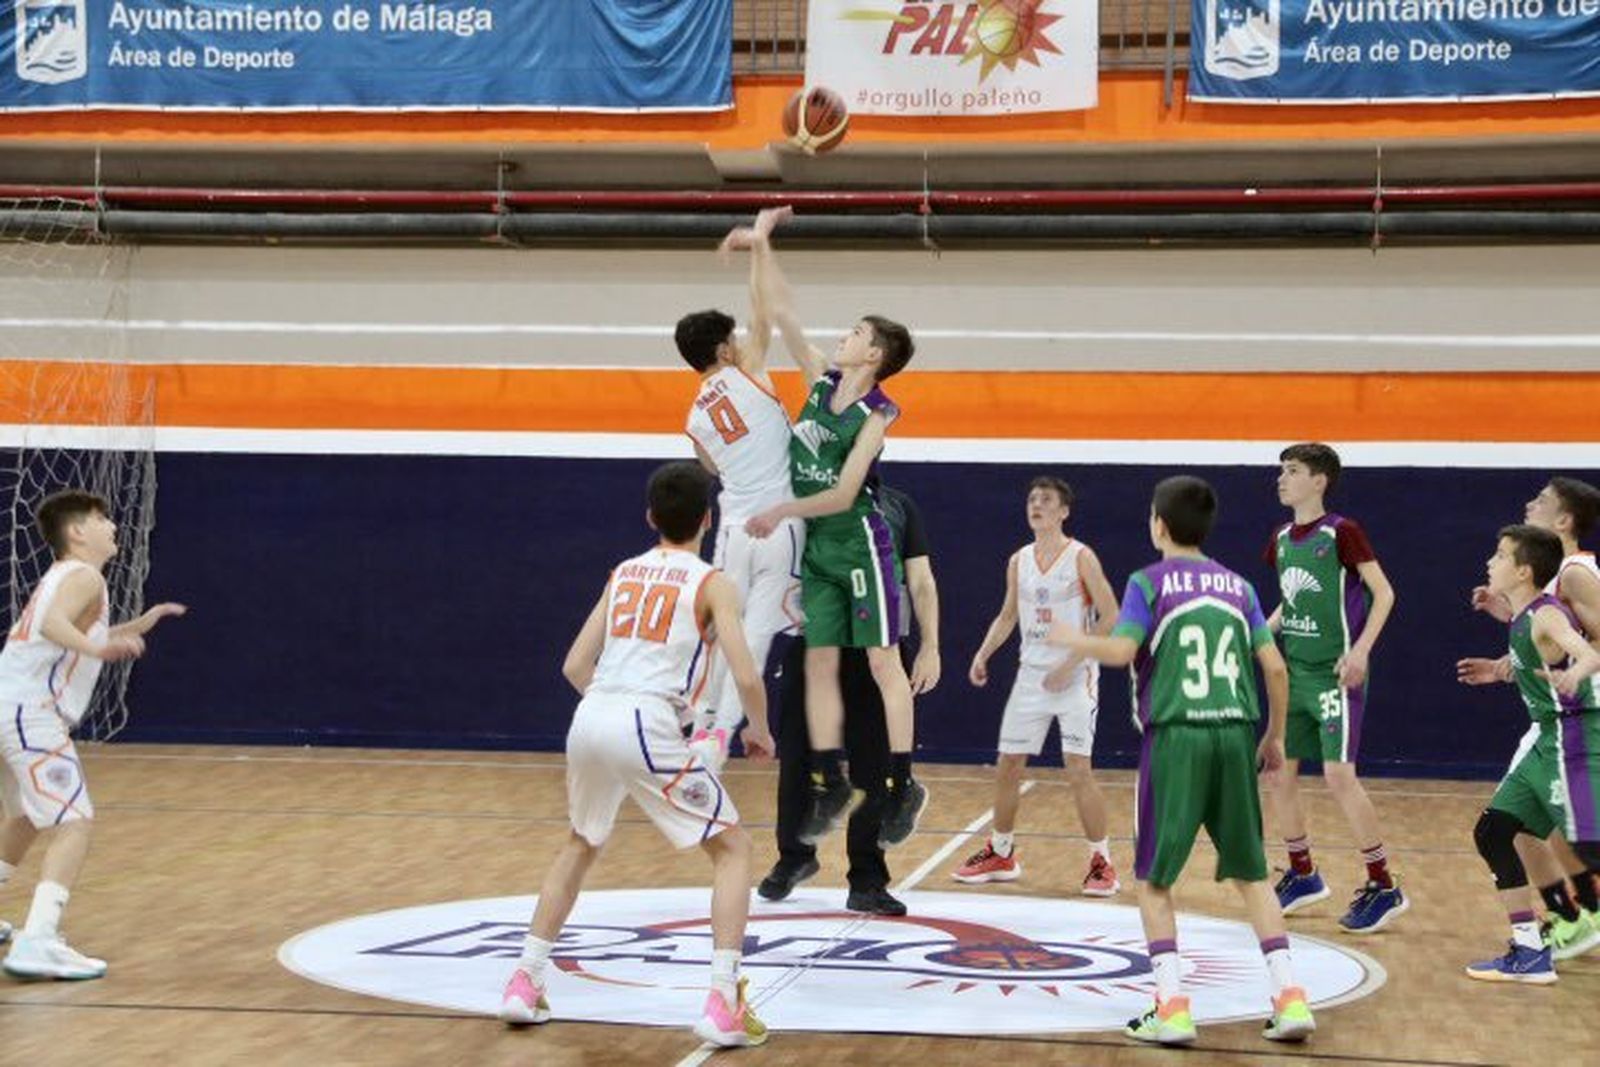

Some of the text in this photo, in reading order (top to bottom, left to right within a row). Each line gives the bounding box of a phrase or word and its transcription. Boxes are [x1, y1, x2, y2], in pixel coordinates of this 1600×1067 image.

[108, 2, 493, 36] Ayuntamiento de Málaga
[1304, 0, 1599, 29] Ayuntamiento de
[108, 41, 294, 71] Área de Deporte
[1304, 37, 1511, 65] Área de Deporte
[857, 88, 952, 112] #orgullo
[706, 394, 750, 445] 0
[1162, 570, 1194, 597] ALE
[610, 581, 680, 643] 20
[1178, 625, 1239, 699] 34
[1319, 689, 1341, 719] 35
